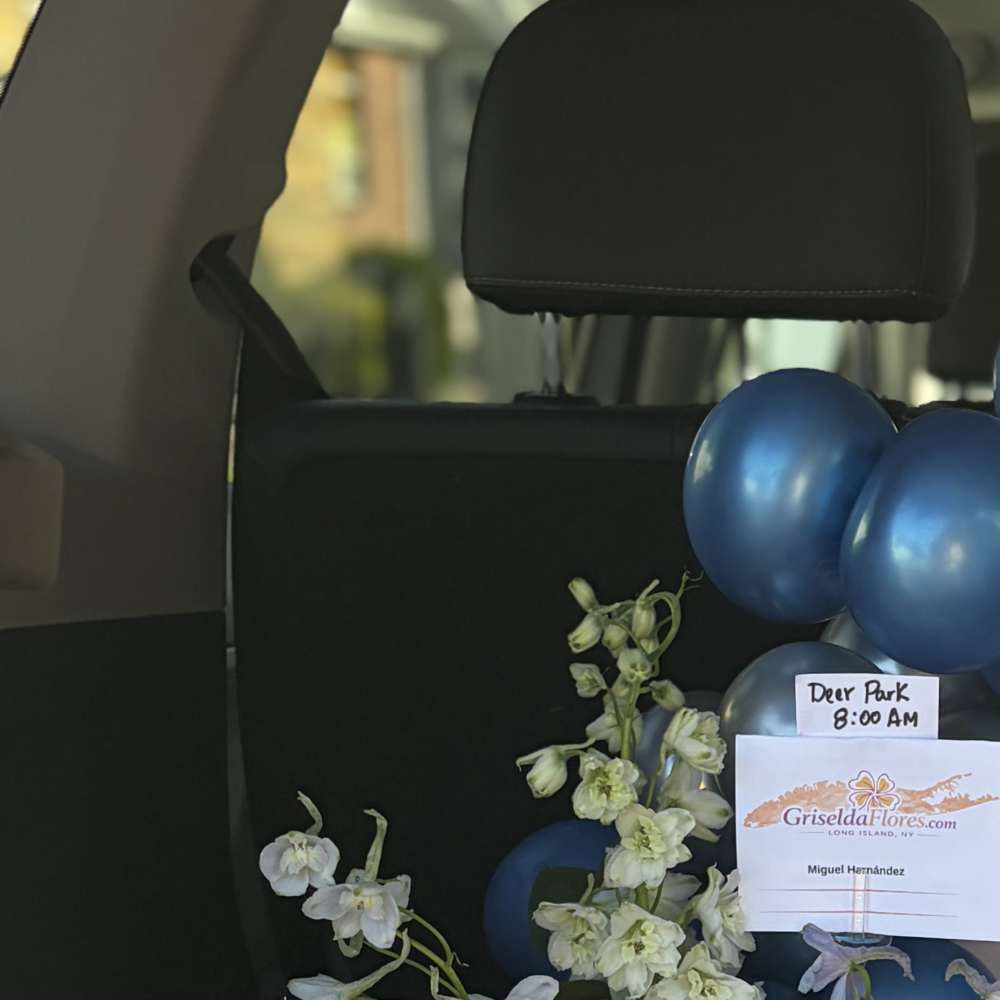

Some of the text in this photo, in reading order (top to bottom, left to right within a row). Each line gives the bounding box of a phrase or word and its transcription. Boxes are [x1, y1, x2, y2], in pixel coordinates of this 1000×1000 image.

[807, 680, 910, 703] Deer Park
[833, 707, 919, 730] 8:00 AM
[782, 806, 957, 830] GriseldaFlores.com
[807, 864, 845, 876] Miguel
